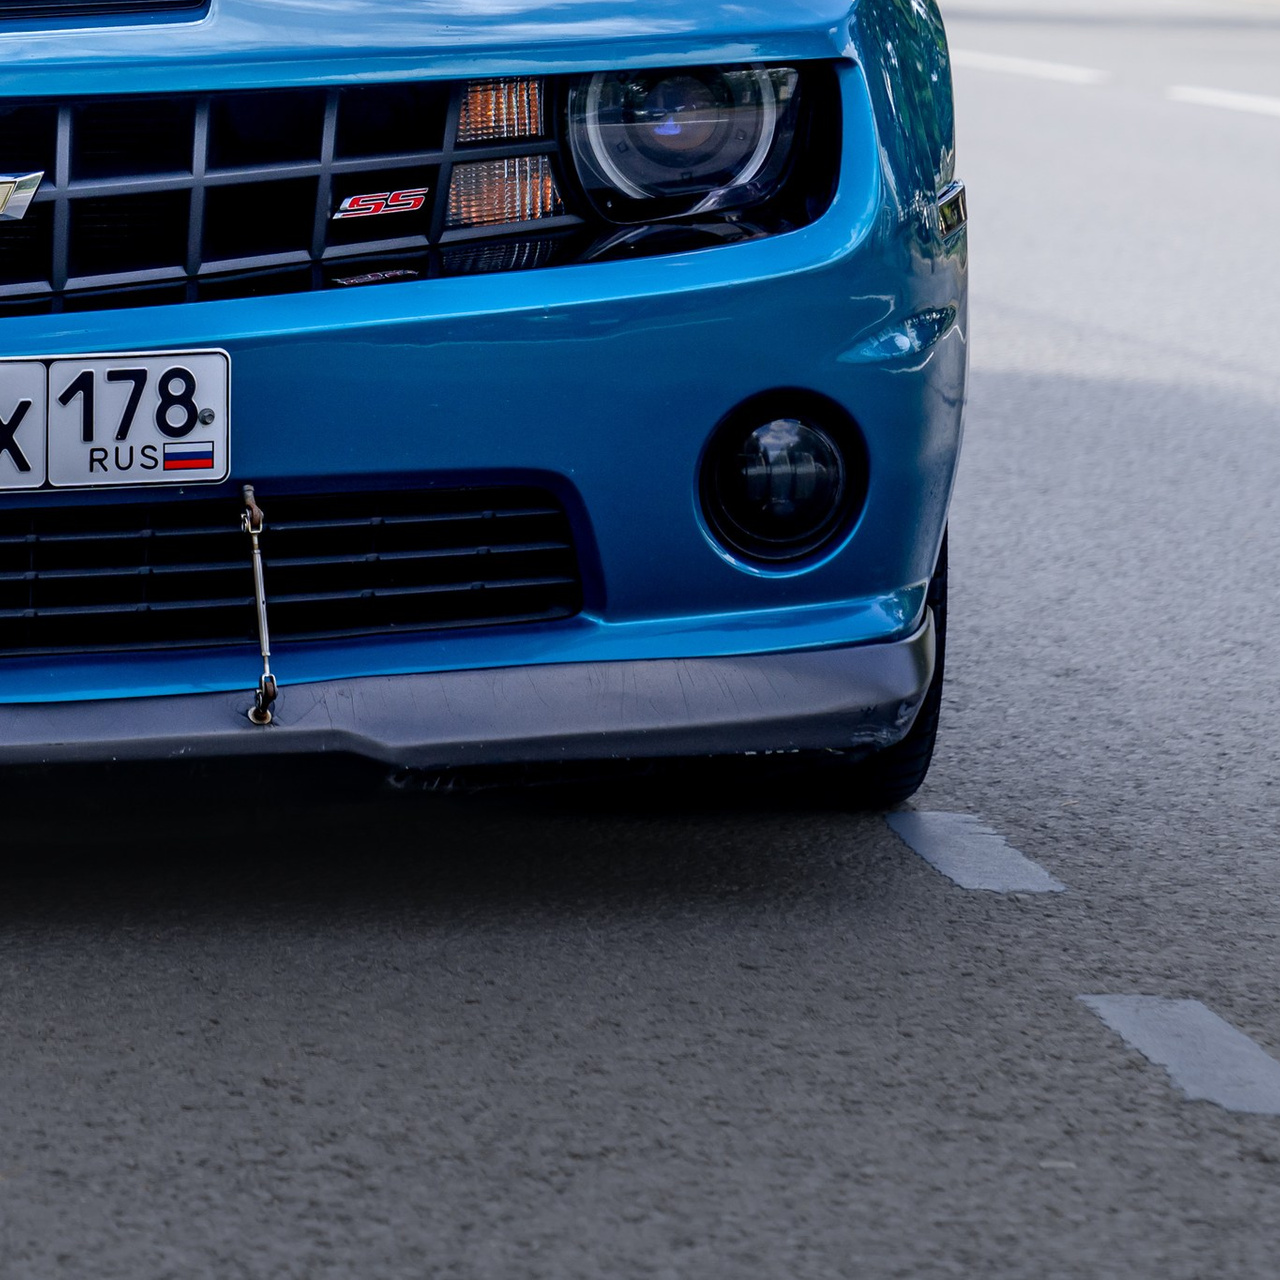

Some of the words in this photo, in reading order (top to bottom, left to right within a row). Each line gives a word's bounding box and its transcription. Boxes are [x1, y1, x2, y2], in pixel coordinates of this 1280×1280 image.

[332, 187, 429, 220] SS
[57, 367, 198, 442] 178
[88, 444, 159, 473] RUS
